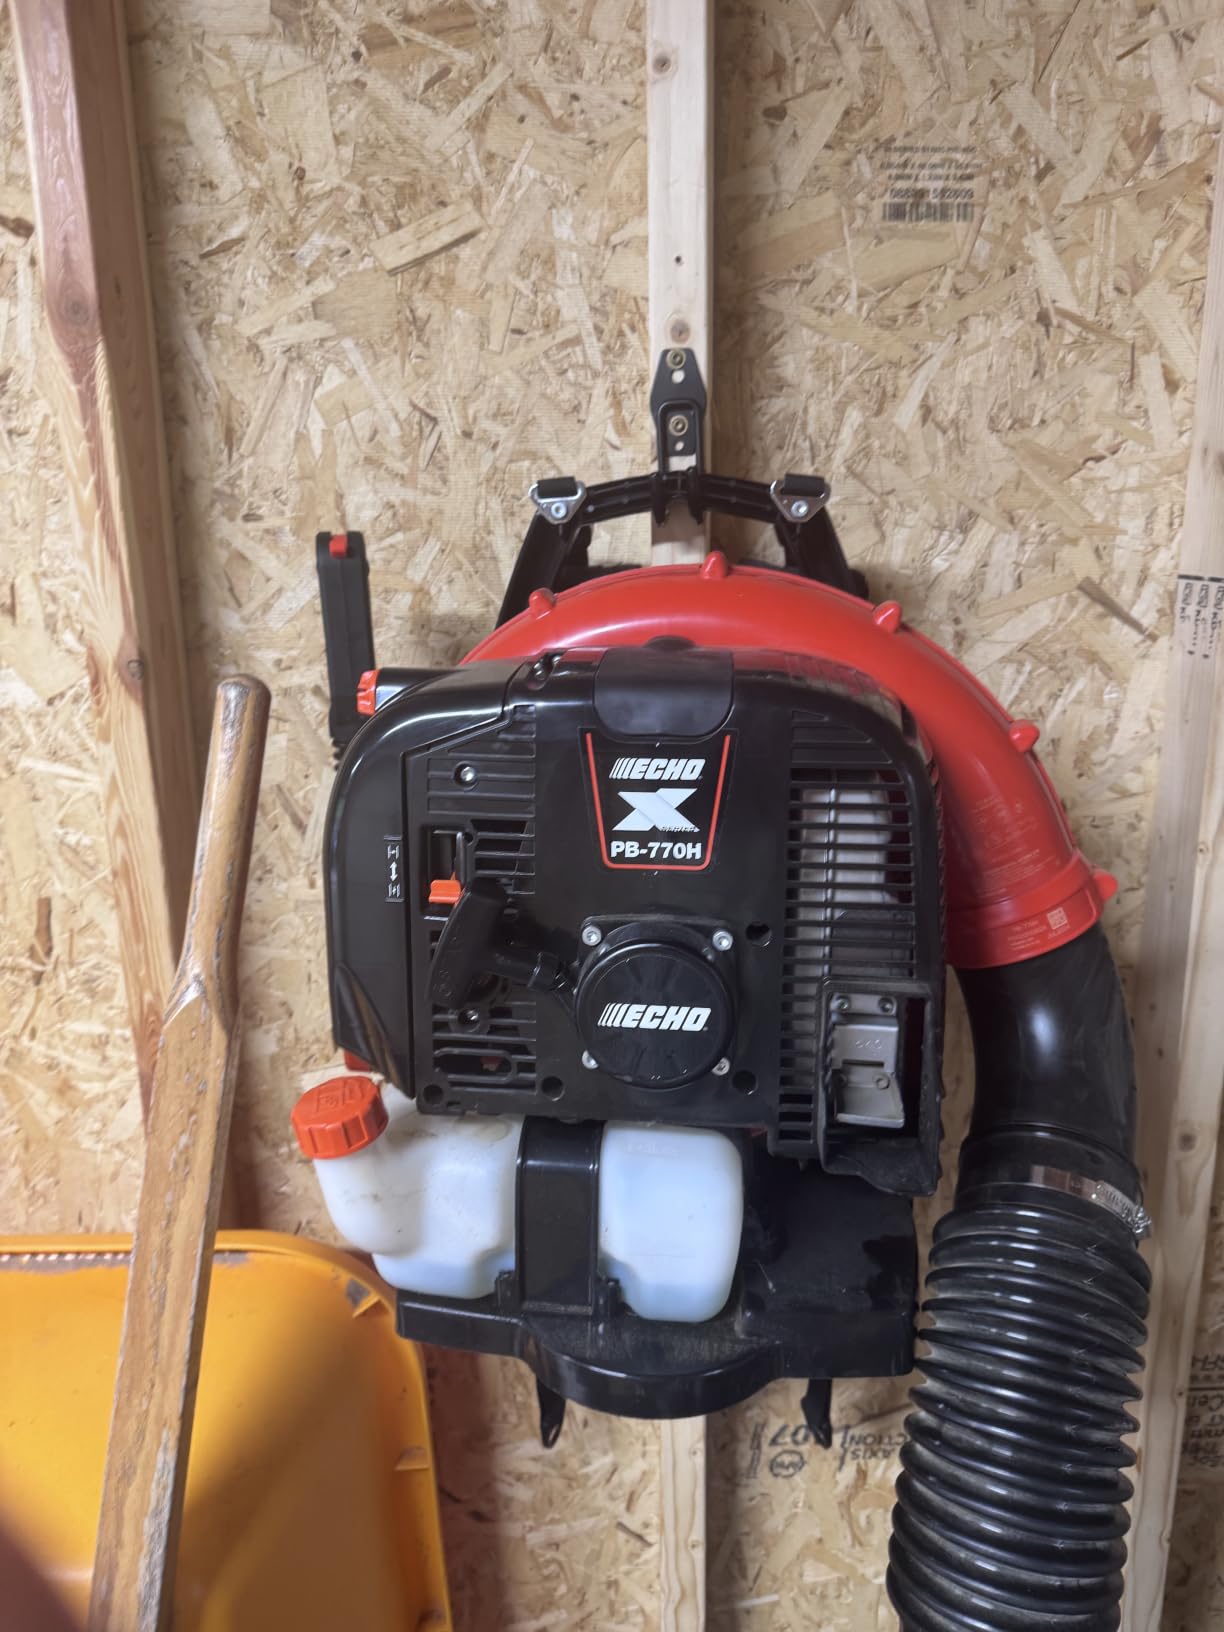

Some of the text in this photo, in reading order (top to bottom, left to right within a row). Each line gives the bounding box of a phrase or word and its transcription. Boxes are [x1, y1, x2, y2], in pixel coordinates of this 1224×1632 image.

[628, 757, 706, 781] ECHO
[610, 841, 702, 860] PB-770H
[618, 1004, 712, 1032] ECHO
[851, 1433, 908, 1447] CTION
